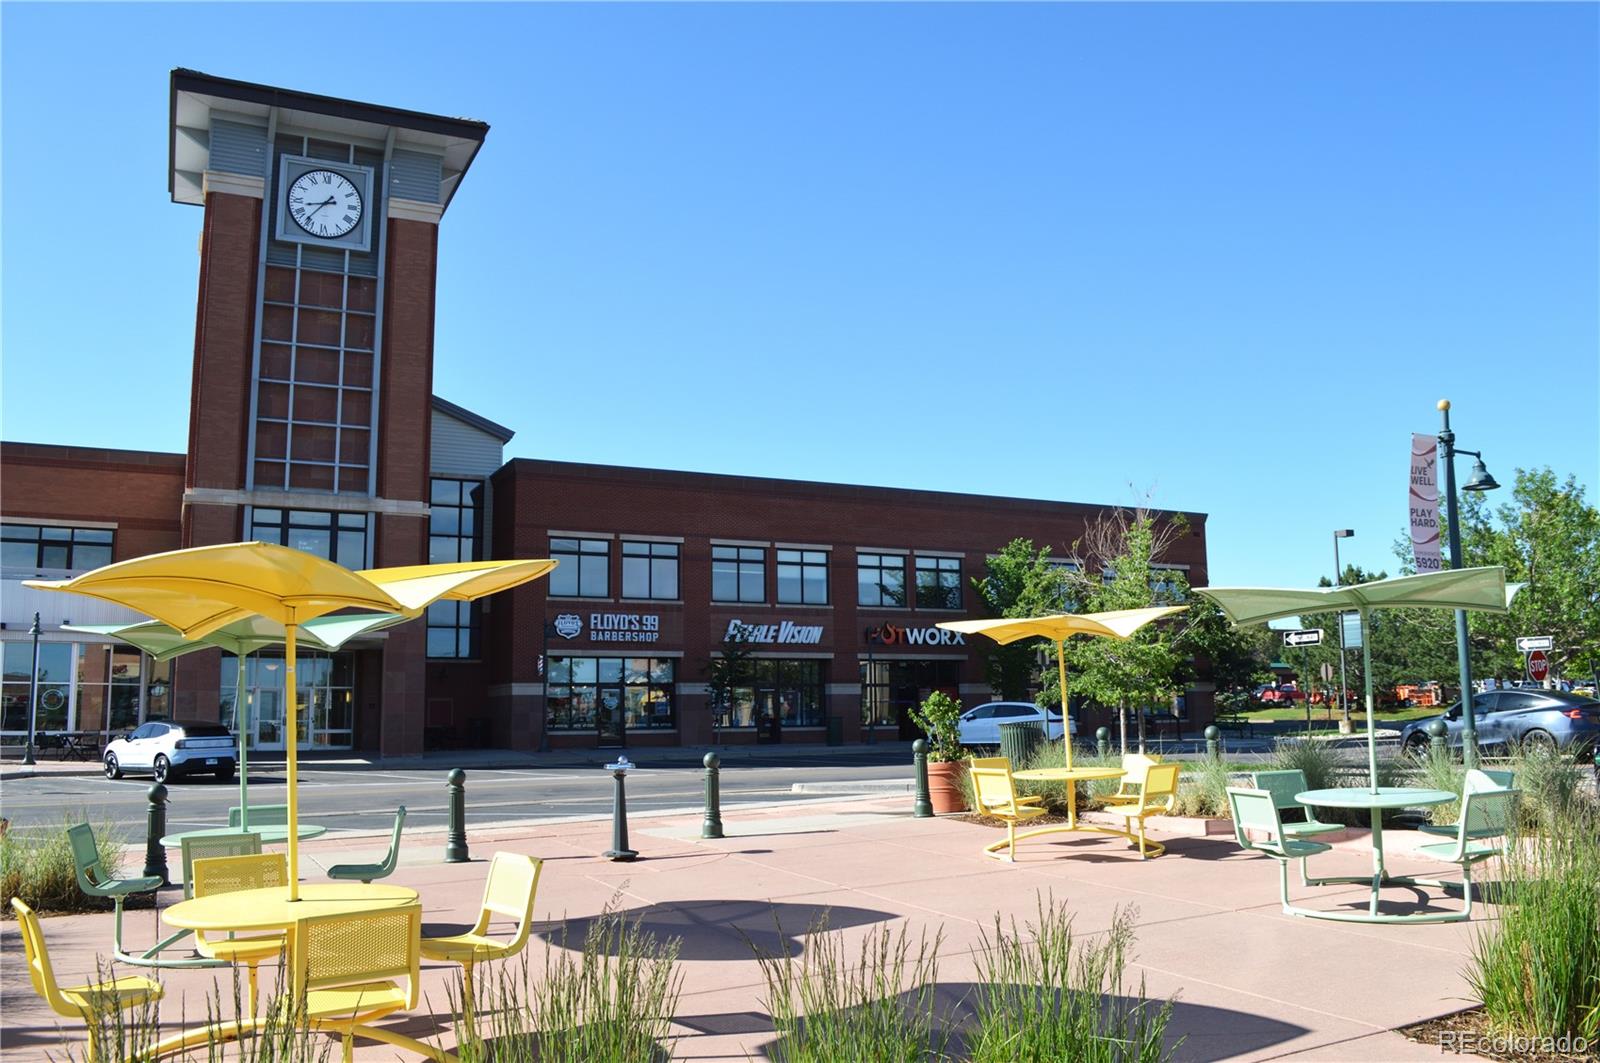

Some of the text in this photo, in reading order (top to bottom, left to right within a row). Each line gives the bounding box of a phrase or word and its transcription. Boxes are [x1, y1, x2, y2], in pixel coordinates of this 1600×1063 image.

[1410, 466, 1428, 476] LIVE
[1410, 476, 1435, 486] WELL.
[1410, 508, 1433, 518] PLAY
[1410, 518, 1439, 528] HARD.
[1415, 557, 1440, 569] 5920
[590, 613, 659, 631] FLOYD'S 99
[590, 631, 659, 642] BARBERSHOP
[777, 621, 824, 644] VISION
[1530, 659, 1546, 672] STOP
